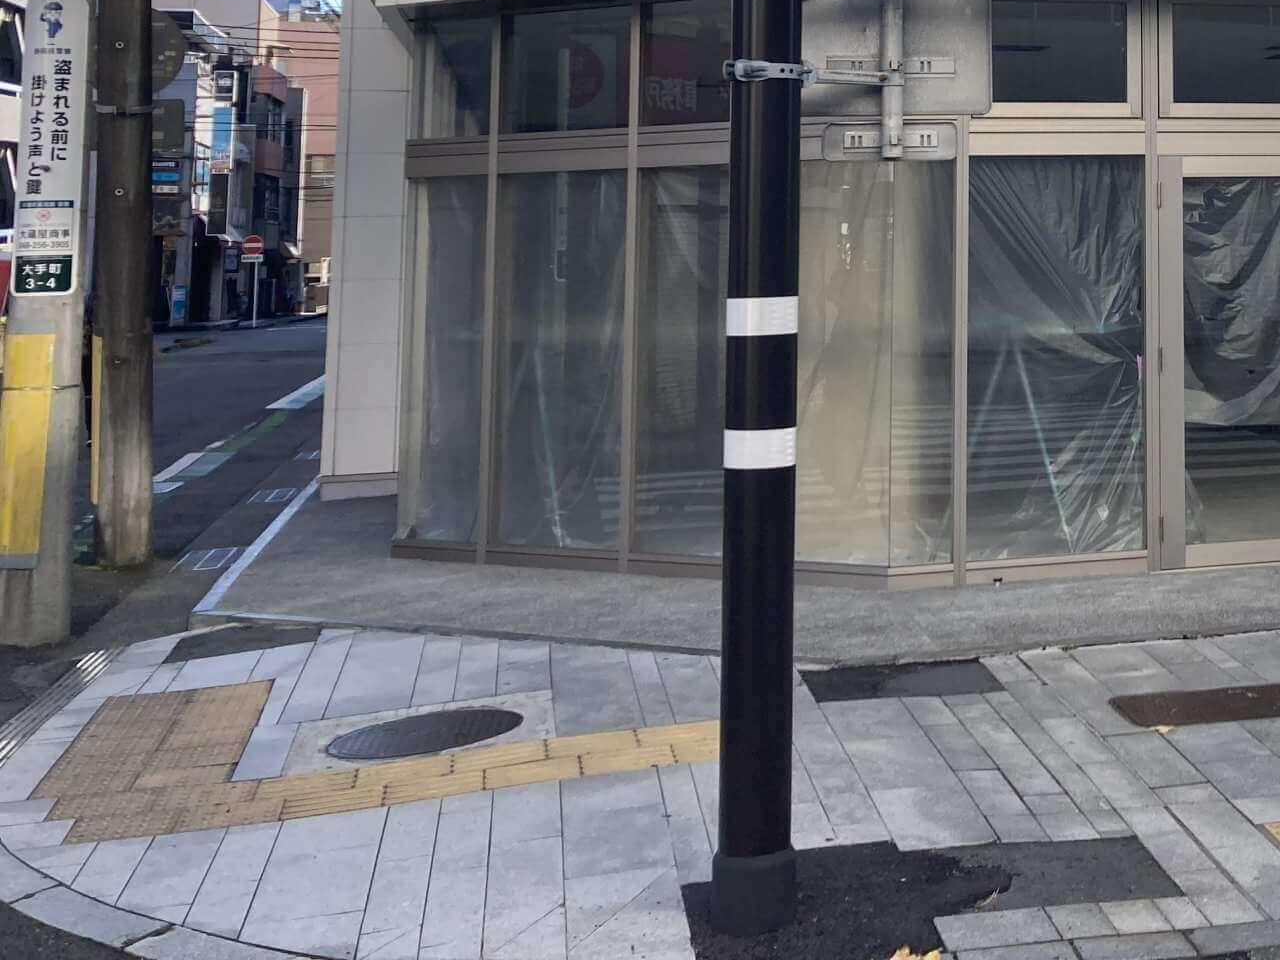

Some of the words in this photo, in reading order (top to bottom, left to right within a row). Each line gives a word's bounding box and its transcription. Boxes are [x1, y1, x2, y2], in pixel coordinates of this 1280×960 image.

[26, 74, 47, 195] 掛けよう声と鍵
[50, 59, 72, 161] 盗まれる前に
[21, 263, 63, 275] 大手町
[25, 277, 56, 289] 3-4
